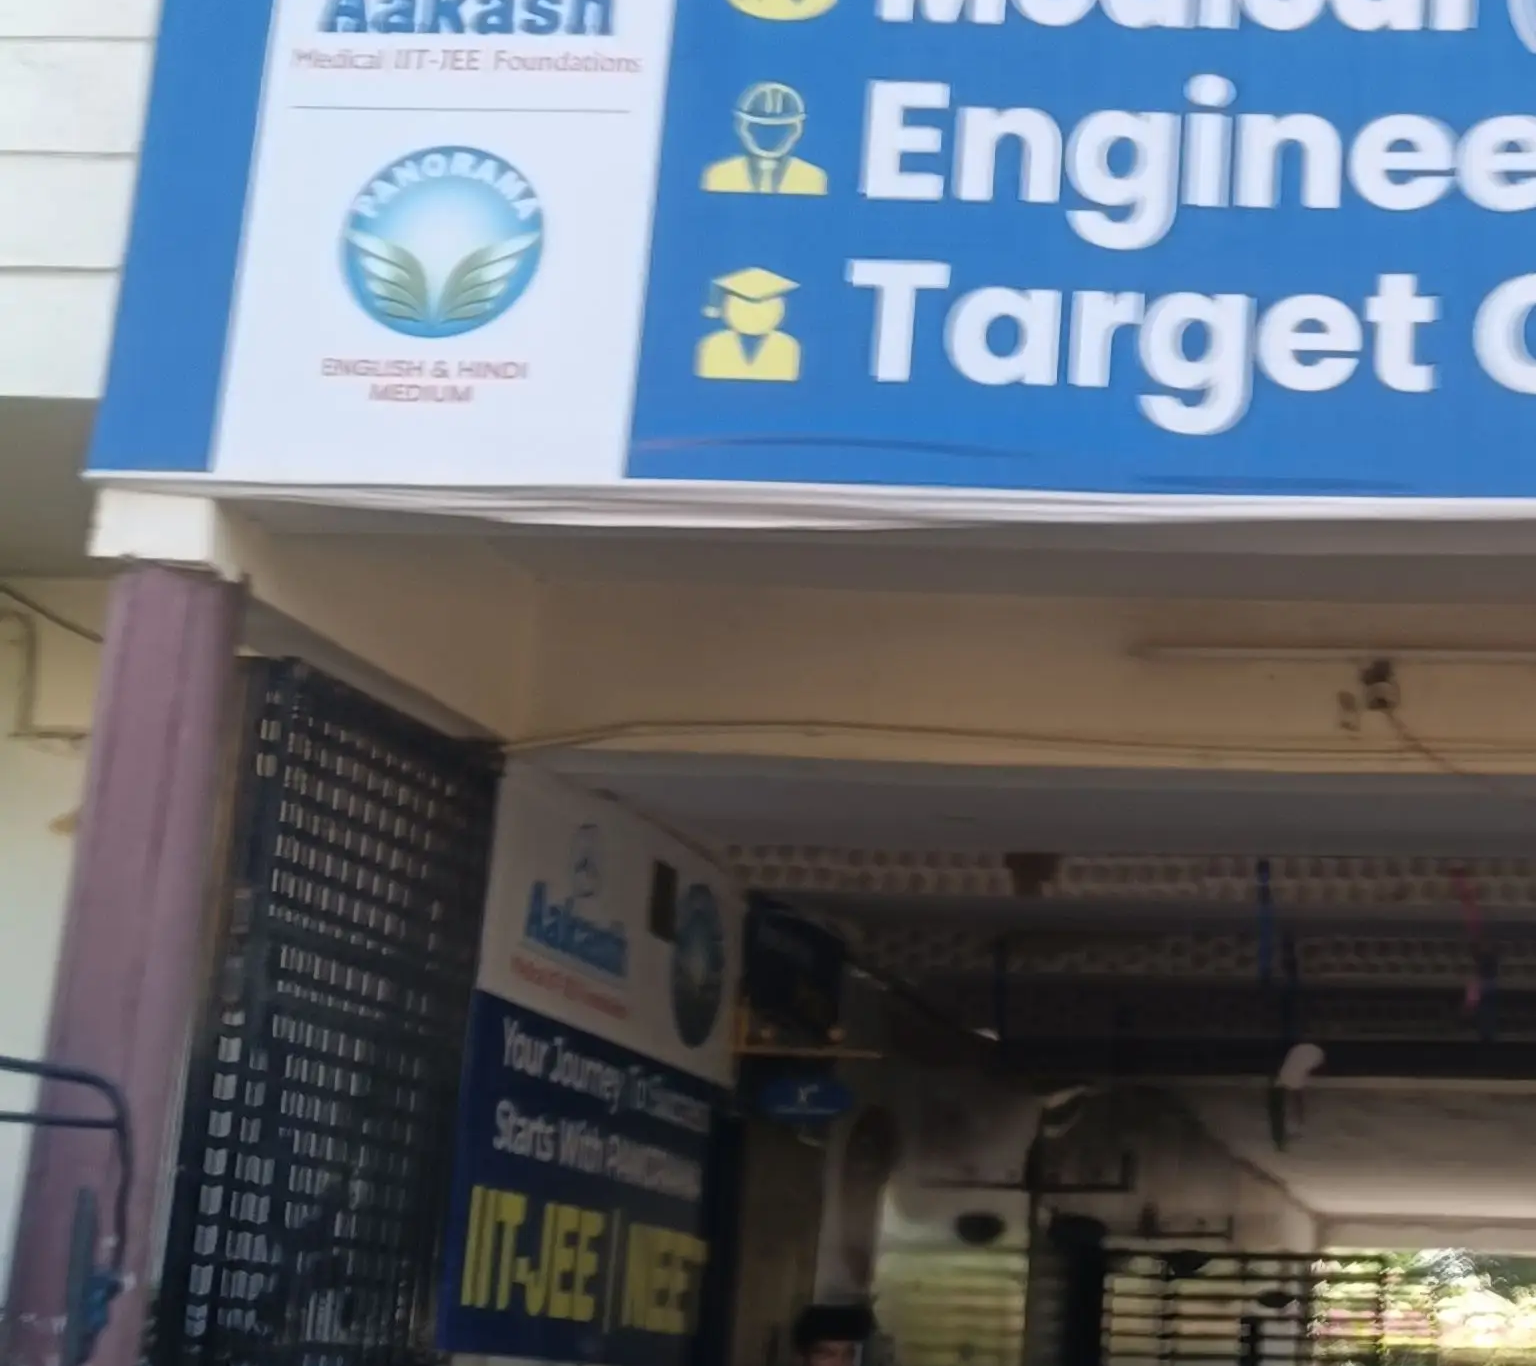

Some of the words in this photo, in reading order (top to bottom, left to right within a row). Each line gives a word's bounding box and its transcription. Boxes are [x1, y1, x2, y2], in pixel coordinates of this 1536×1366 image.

[353, 151, 540, 221] PANORAMA
[321, 357, 425, 378] ENGLISH
[430, 360, 452, 379] &
[456, 361, 531, 380] HINDI
[843, 257, 1442, 435] Target
[368, 383, 475, 403] MEDIUM
